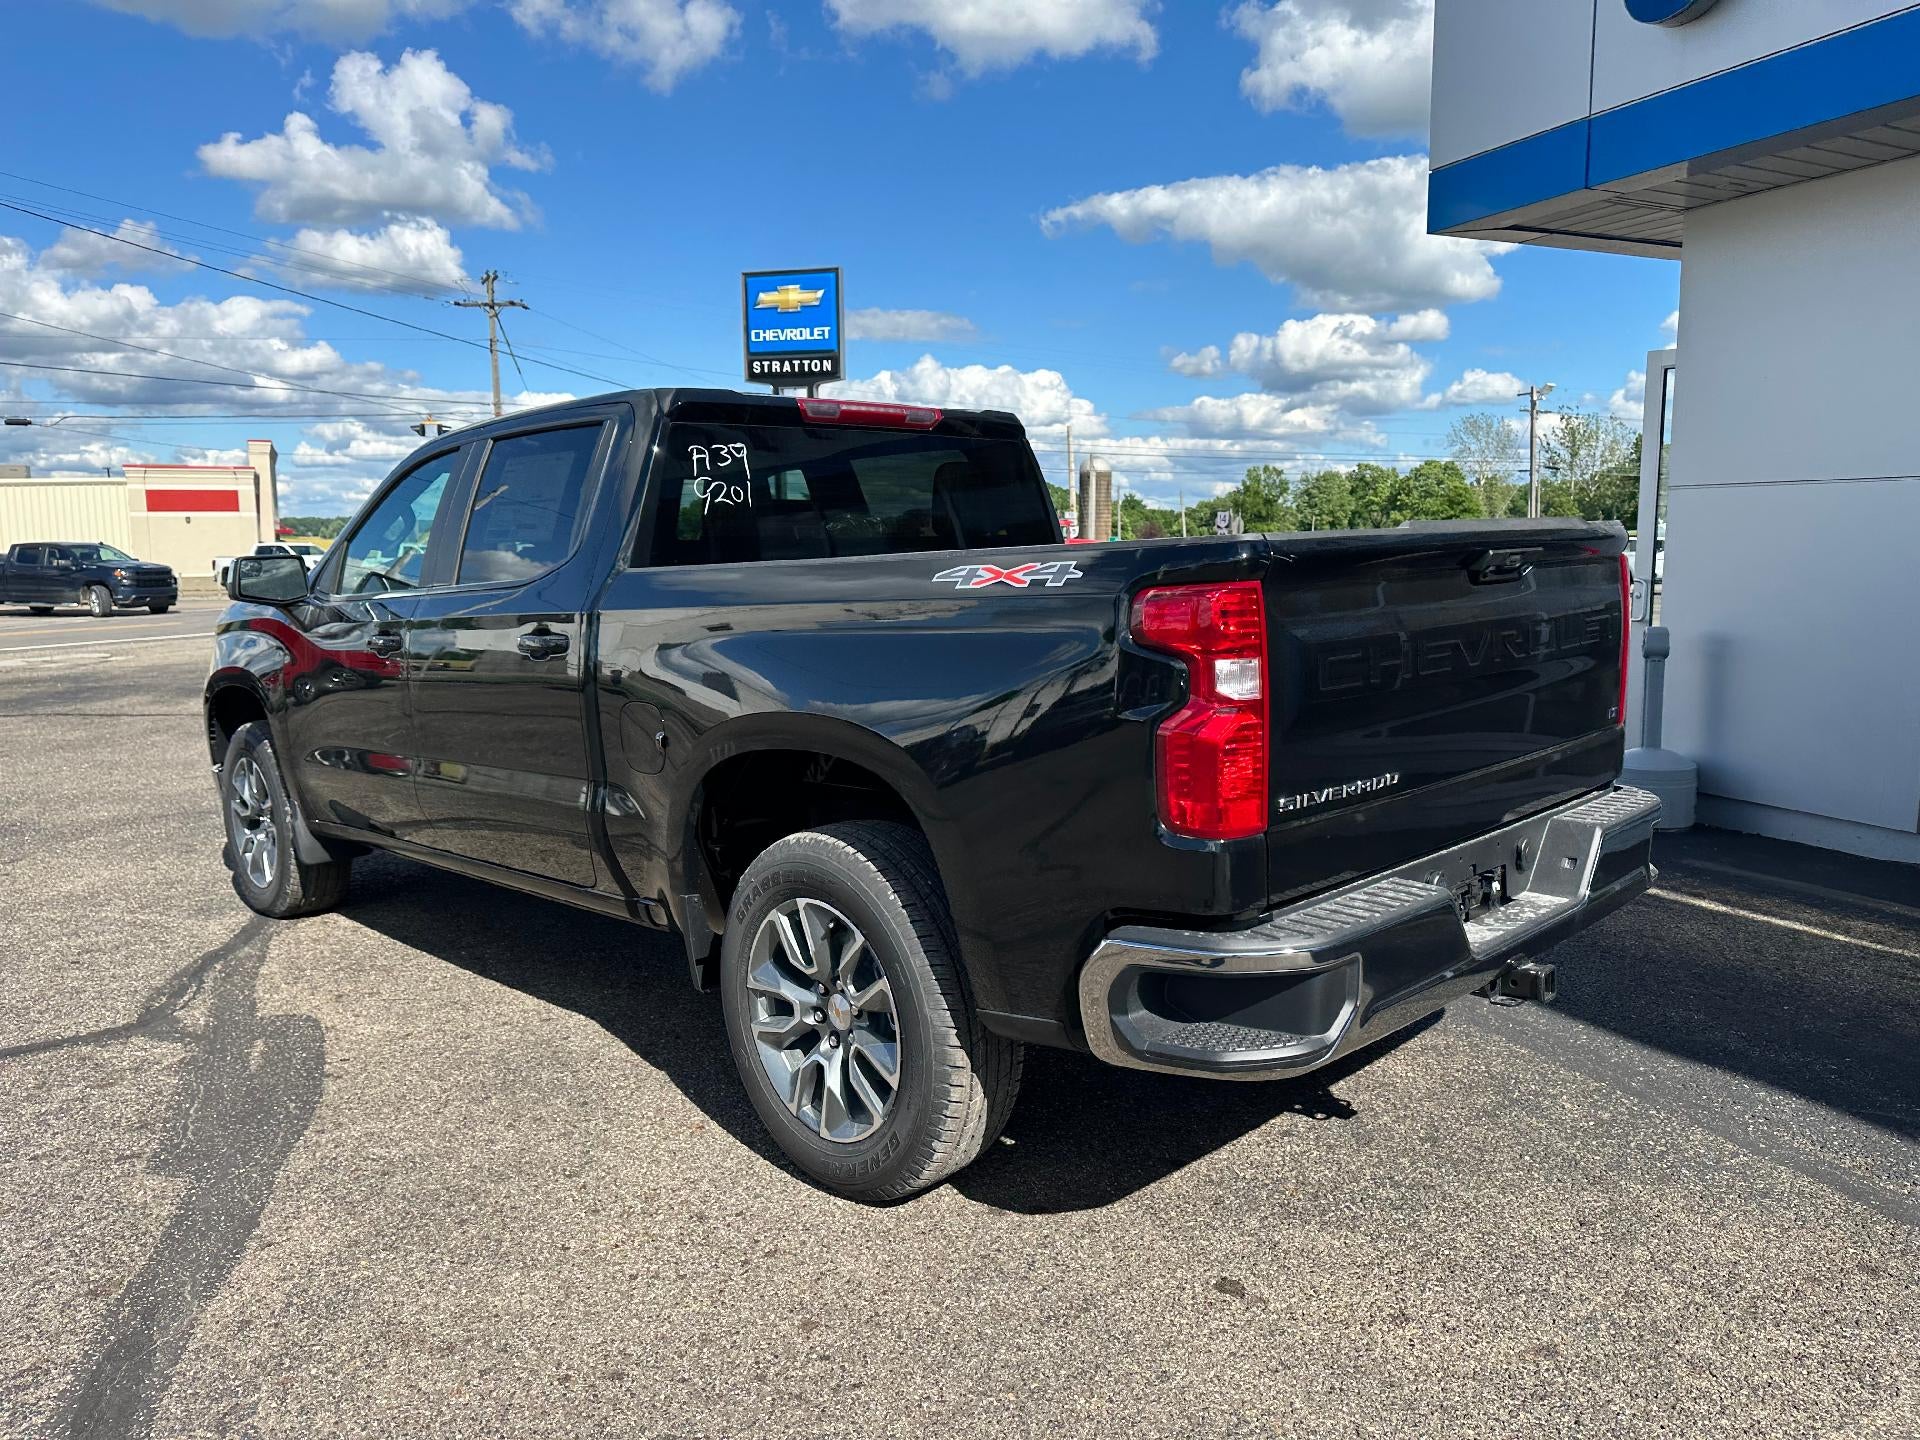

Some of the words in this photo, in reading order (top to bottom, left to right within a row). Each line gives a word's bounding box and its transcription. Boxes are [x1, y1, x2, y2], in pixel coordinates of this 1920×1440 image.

[750, 327, 831, 342] CHEVROLET
[752, 360, 832, 373] STRATTON
[1278, 771, 1399, 815] SILVERADO
